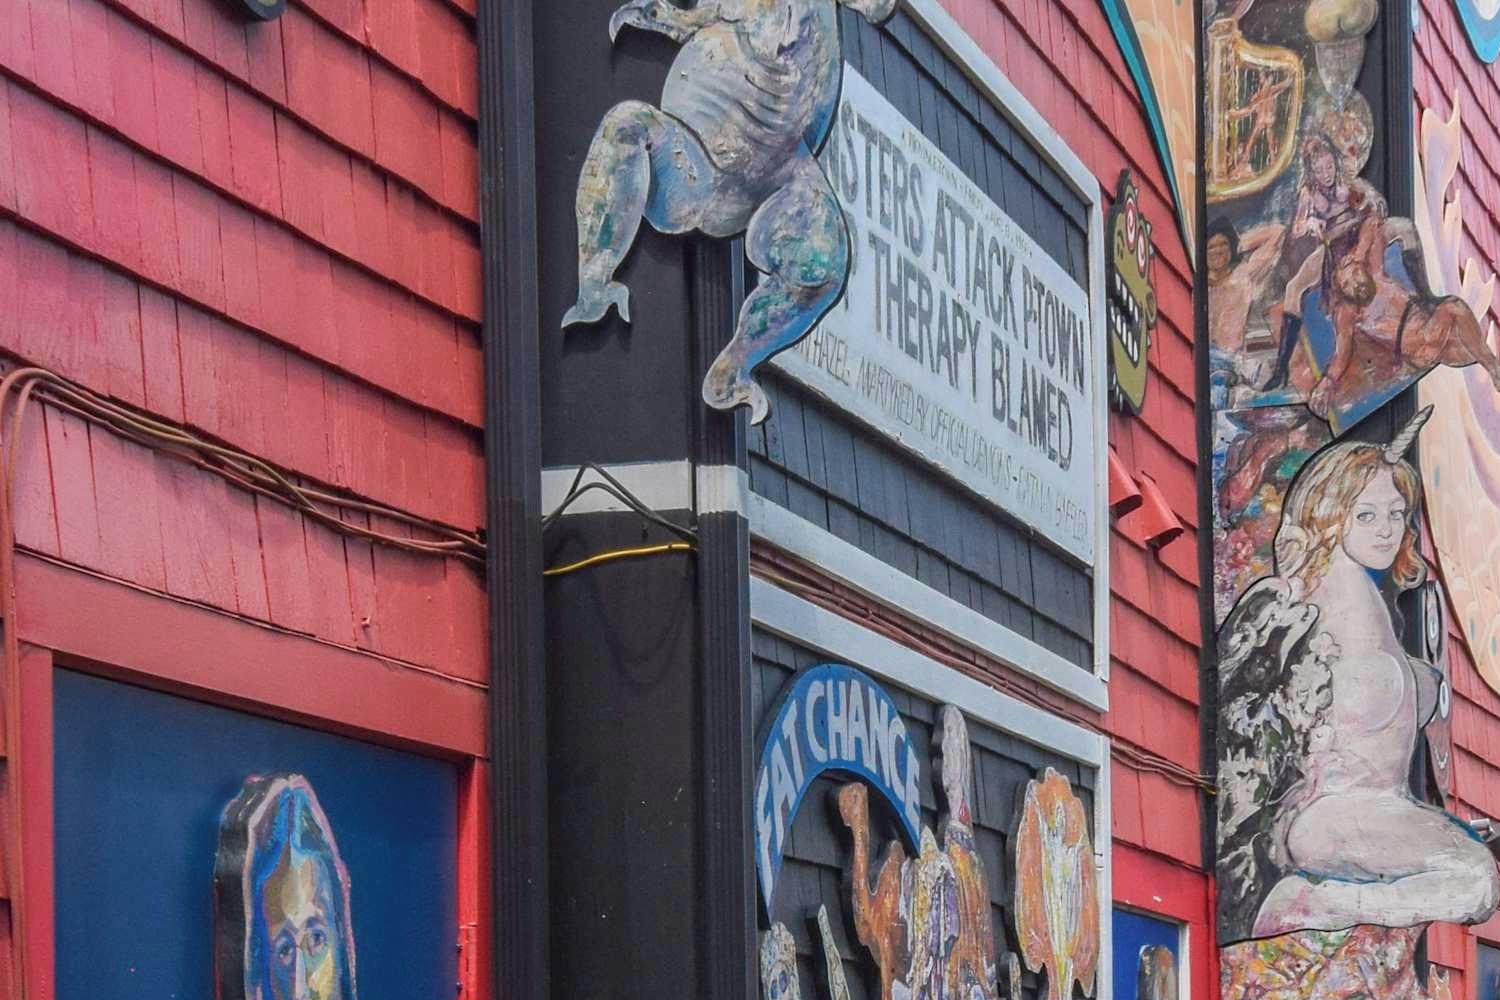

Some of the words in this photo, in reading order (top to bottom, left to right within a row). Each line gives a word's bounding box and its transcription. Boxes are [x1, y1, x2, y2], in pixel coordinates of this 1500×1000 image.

[868, 230, 981, 402] THERAPY
[990, 330, 1073, 472] BLAMED
[932, 188, 1019, 342] ATTACK
[756, 699, 804, 908] FAT
[805, 679, 920, 838] CHANCE
